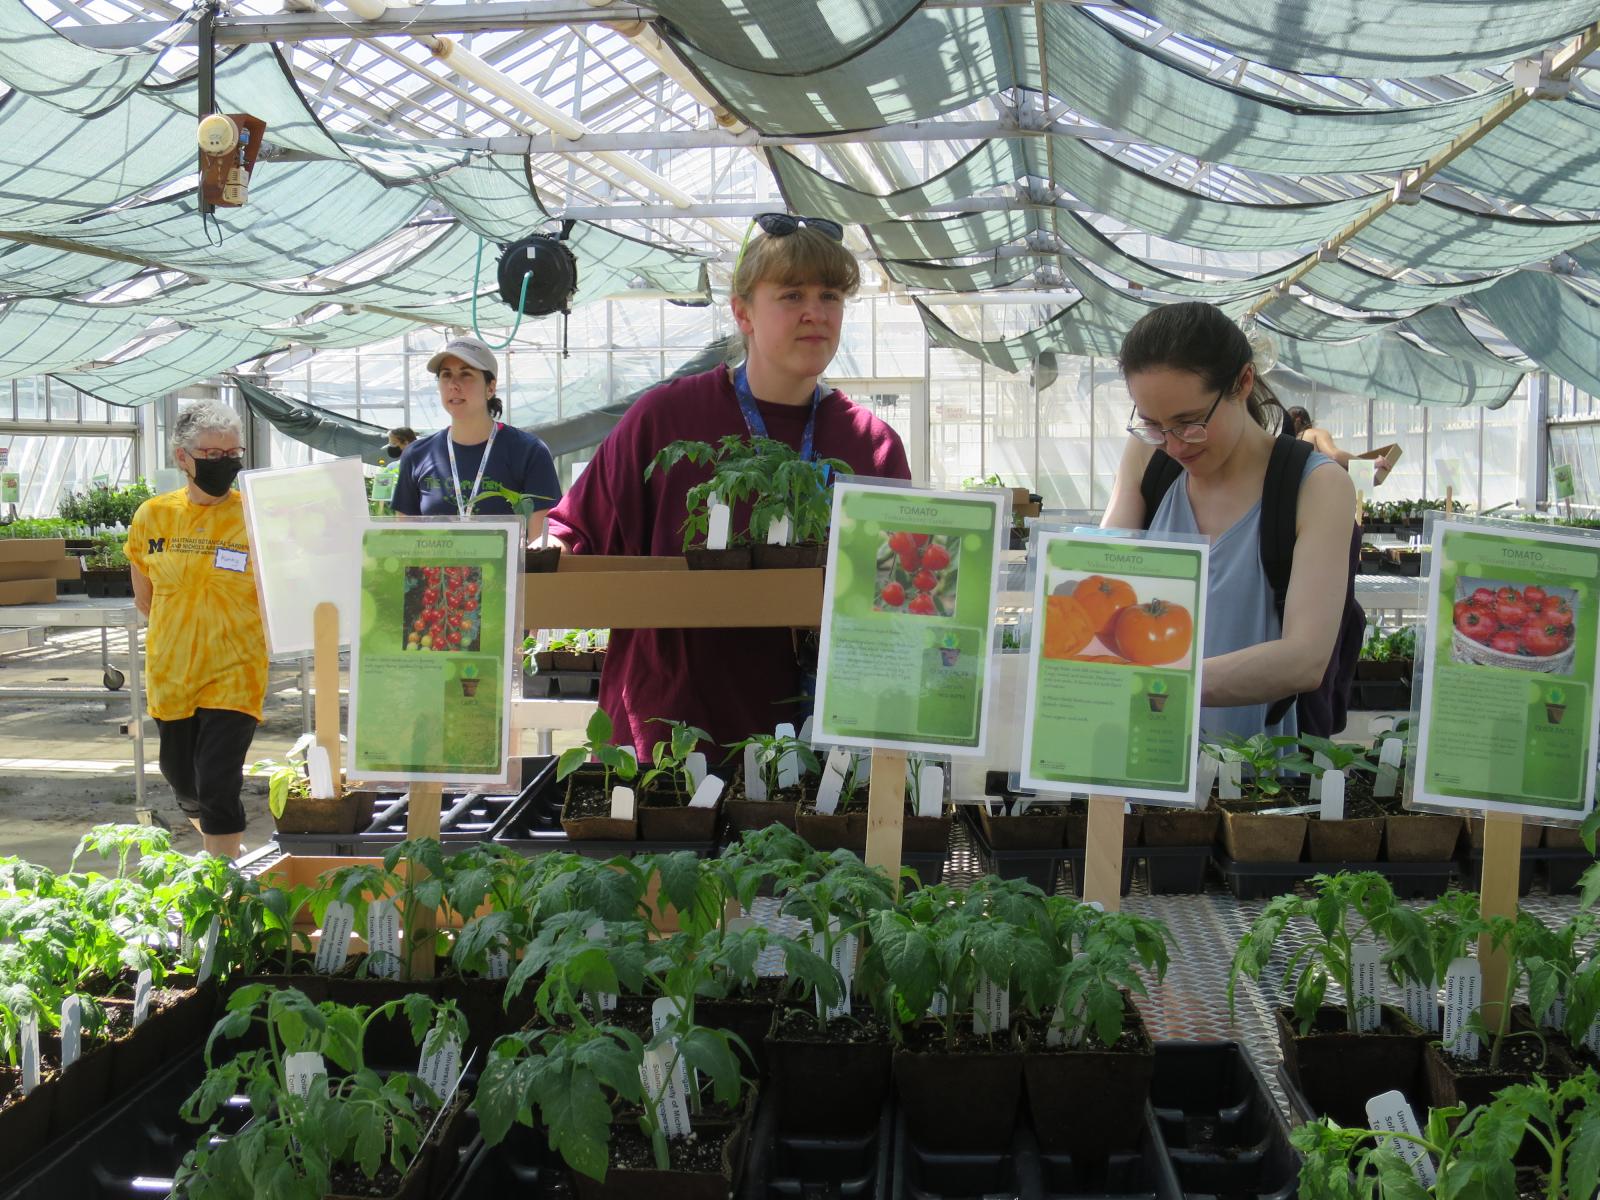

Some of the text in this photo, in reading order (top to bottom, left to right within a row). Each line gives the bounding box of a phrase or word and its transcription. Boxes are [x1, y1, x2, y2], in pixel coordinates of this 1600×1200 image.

[901, 506, 938, 517] TOMATO
[148, 538, 165, 554] M
[417, 540, 453, 548] TOMATO
[1104, 553, 1143, 565] TOMATO
[1502, 548, 1543, 561] TOMATO
[441, 1052, 456, 1088] University
